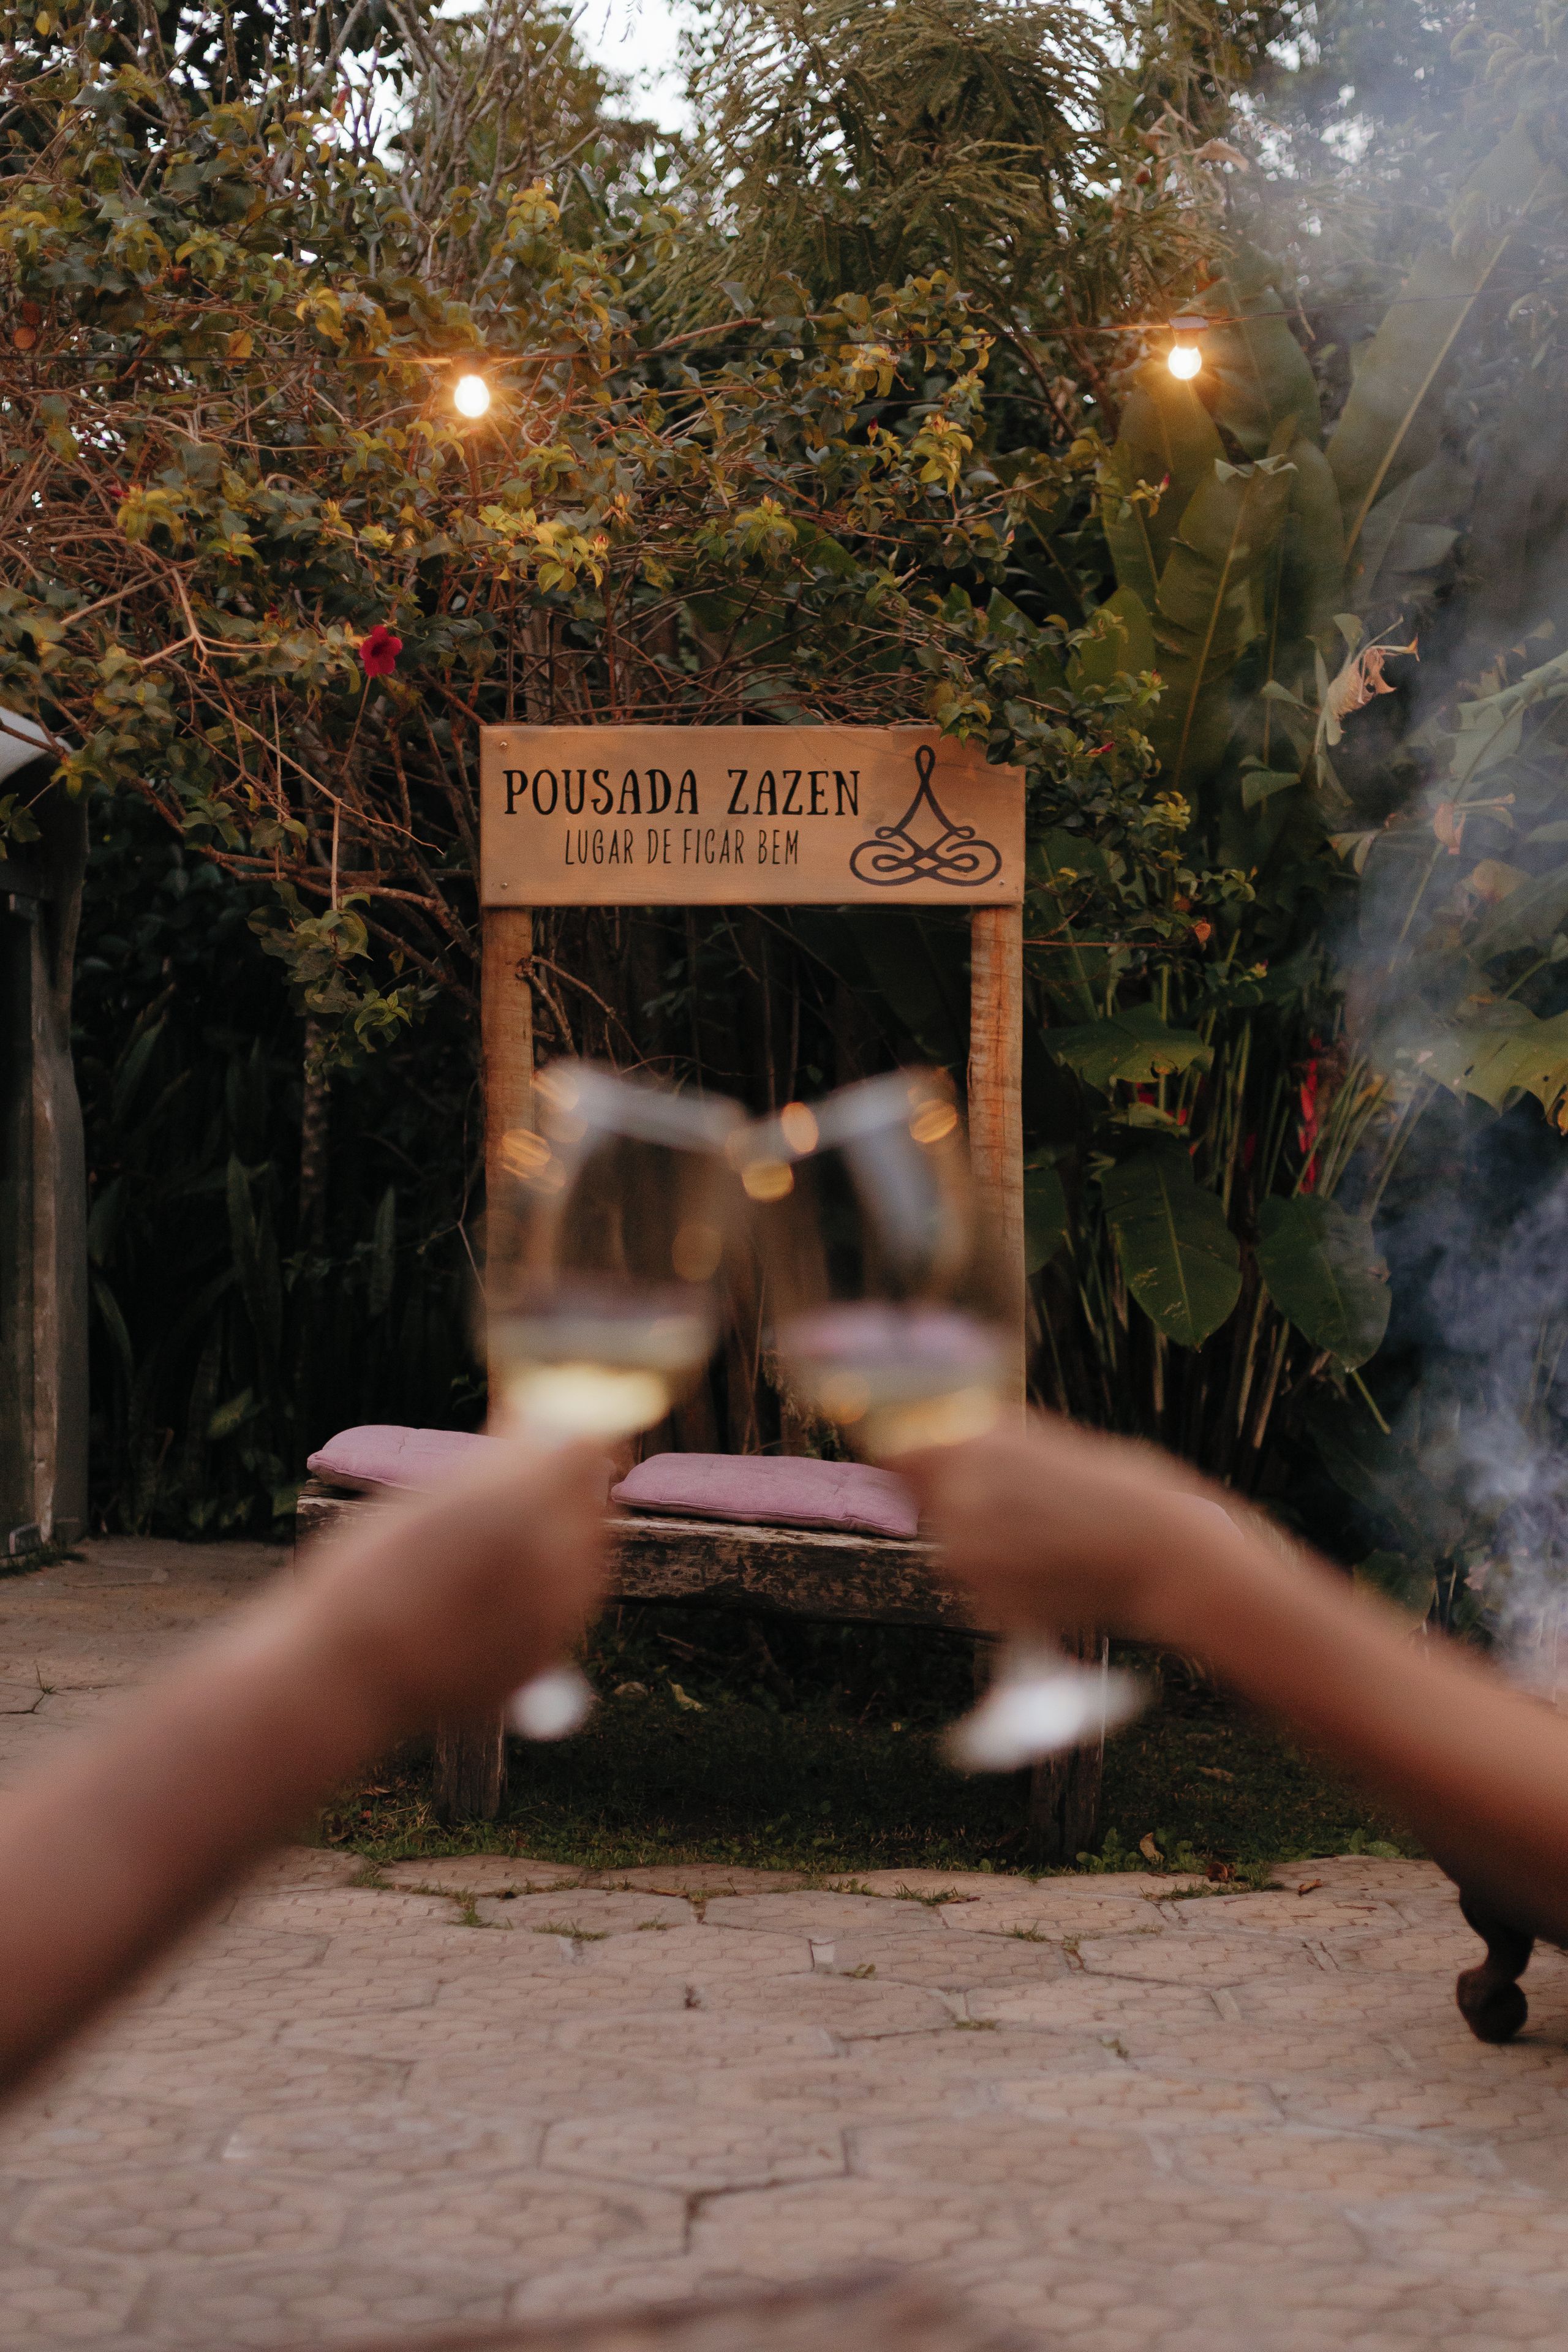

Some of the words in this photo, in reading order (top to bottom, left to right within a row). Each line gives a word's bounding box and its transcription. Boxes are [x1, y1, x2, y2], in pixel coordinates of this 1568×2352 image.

[503, 769, 699, 816] POUSADA
[728, 769, 861, 816] ZAZEN
[565, 829, 633, 865] LUGAR
[647, 829, 671, 864] DE
[683, 829, 744, 864] FICAR
[758, 829, 799, 865] BEM
